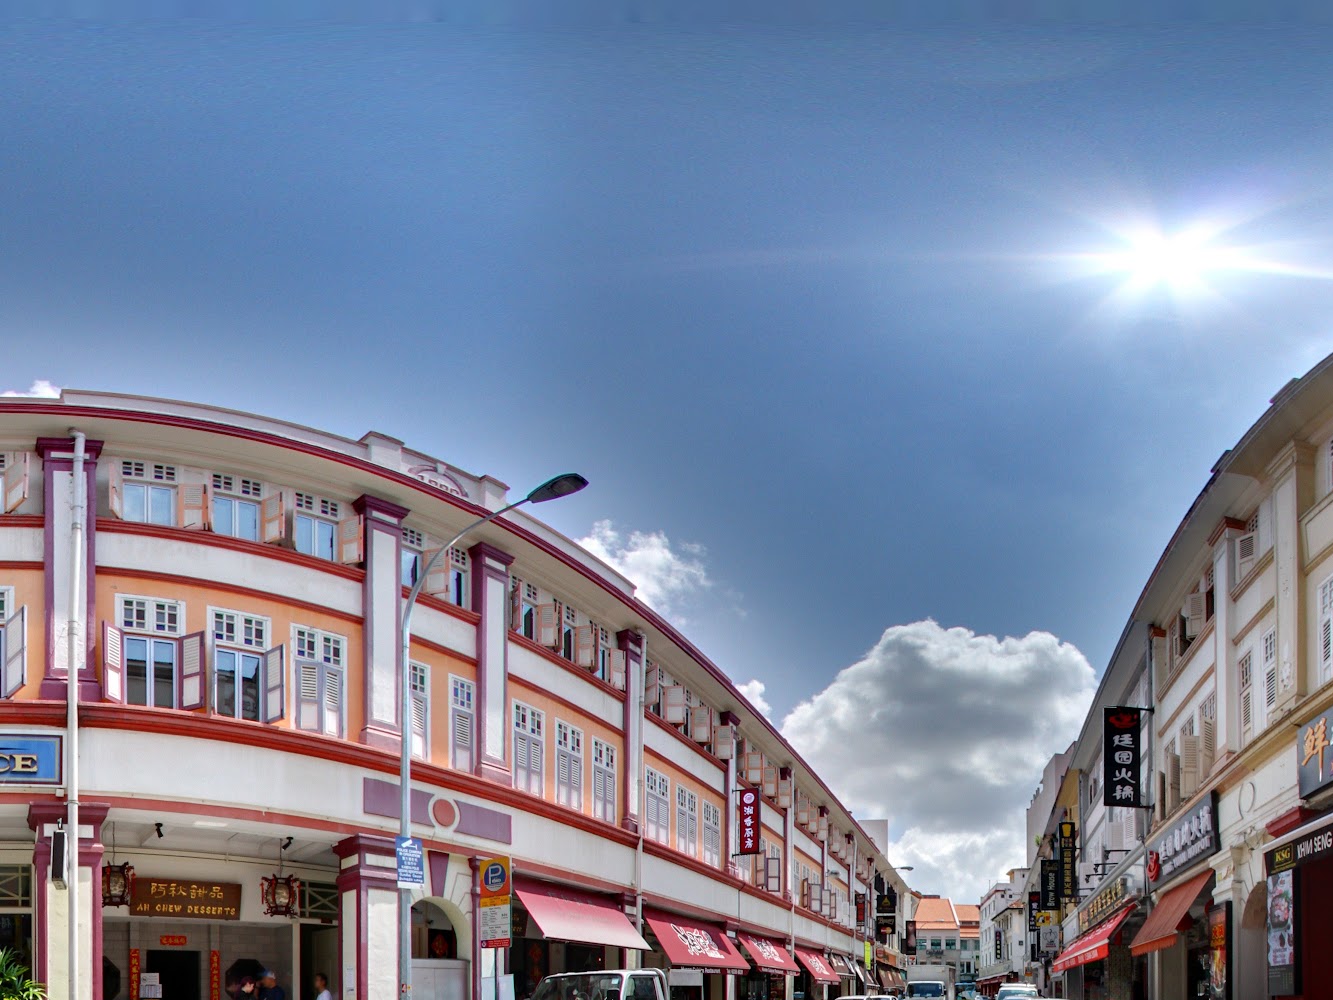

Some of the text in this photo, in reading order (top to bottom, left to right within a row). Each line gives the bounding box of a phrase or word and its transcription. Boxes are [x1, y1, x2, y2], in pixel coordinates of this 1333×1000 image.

[1313, 831, 1333, 853] SENG
[1274, 849, 1291, 862] KSG
[488, 865, 502, 885] P
[150, 882, 224, 900] 阿秋甜品
[136, 903, 236, 915] AH CHEW DESSERTS
